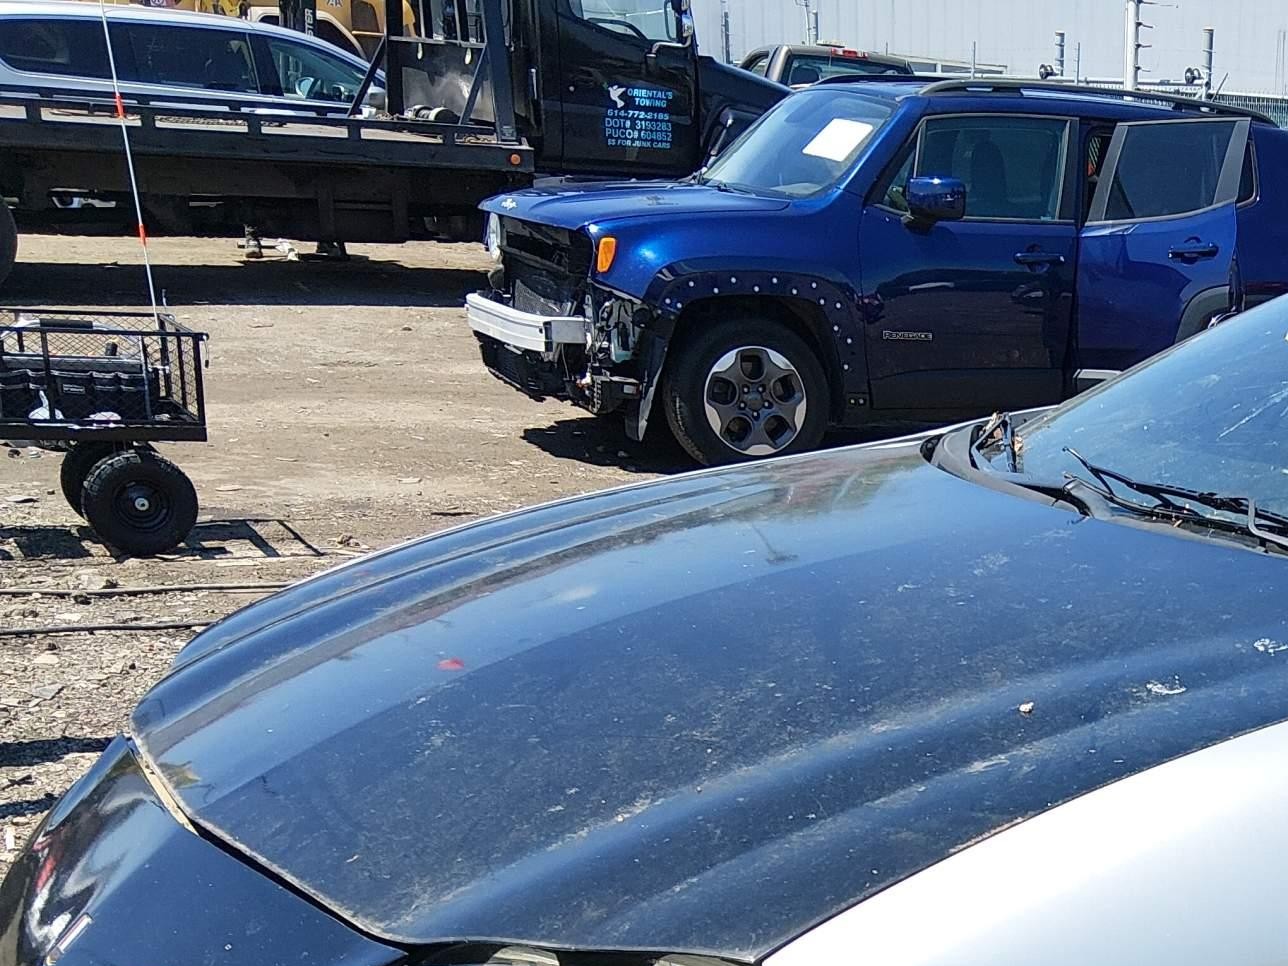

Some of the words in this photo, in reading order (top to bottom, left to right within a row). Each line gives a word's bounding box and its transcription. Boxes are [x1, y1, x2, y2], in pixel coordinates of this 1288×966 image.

[304, 8, 314, 36] STER
[627, 88, 673, 99] ORIENTAL'S
[634, 98, 667, 107] TOWING
[605, 118, 631, 128] DOT#
[605, 128, 639, 139] PUCO#
[632, 140, 651, 148] JUNK
[653, 141, 671, 149] CARS
[882, 330, 933, 340] RENEGADE
